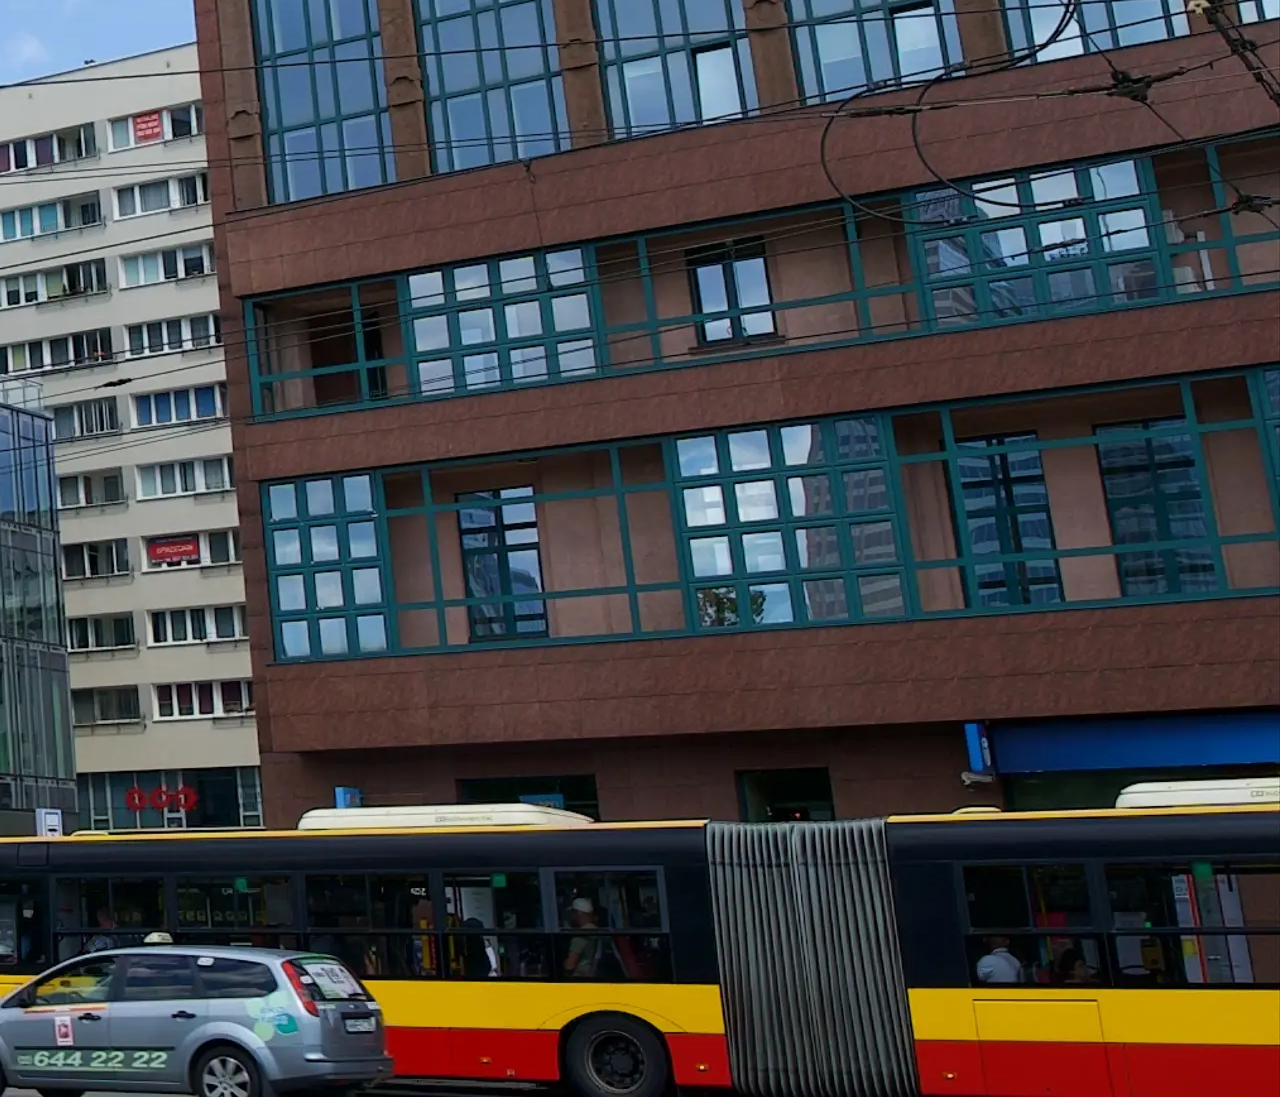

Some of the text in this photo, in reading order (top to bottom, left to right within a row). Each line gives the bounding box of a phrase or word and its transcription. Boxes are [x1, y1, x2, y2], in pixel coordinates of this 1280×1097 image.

[33, 1051, 82, 1068] 644
[90, 1051, 125, 1068] 22
[132, 1052, 168, 1069] 22
